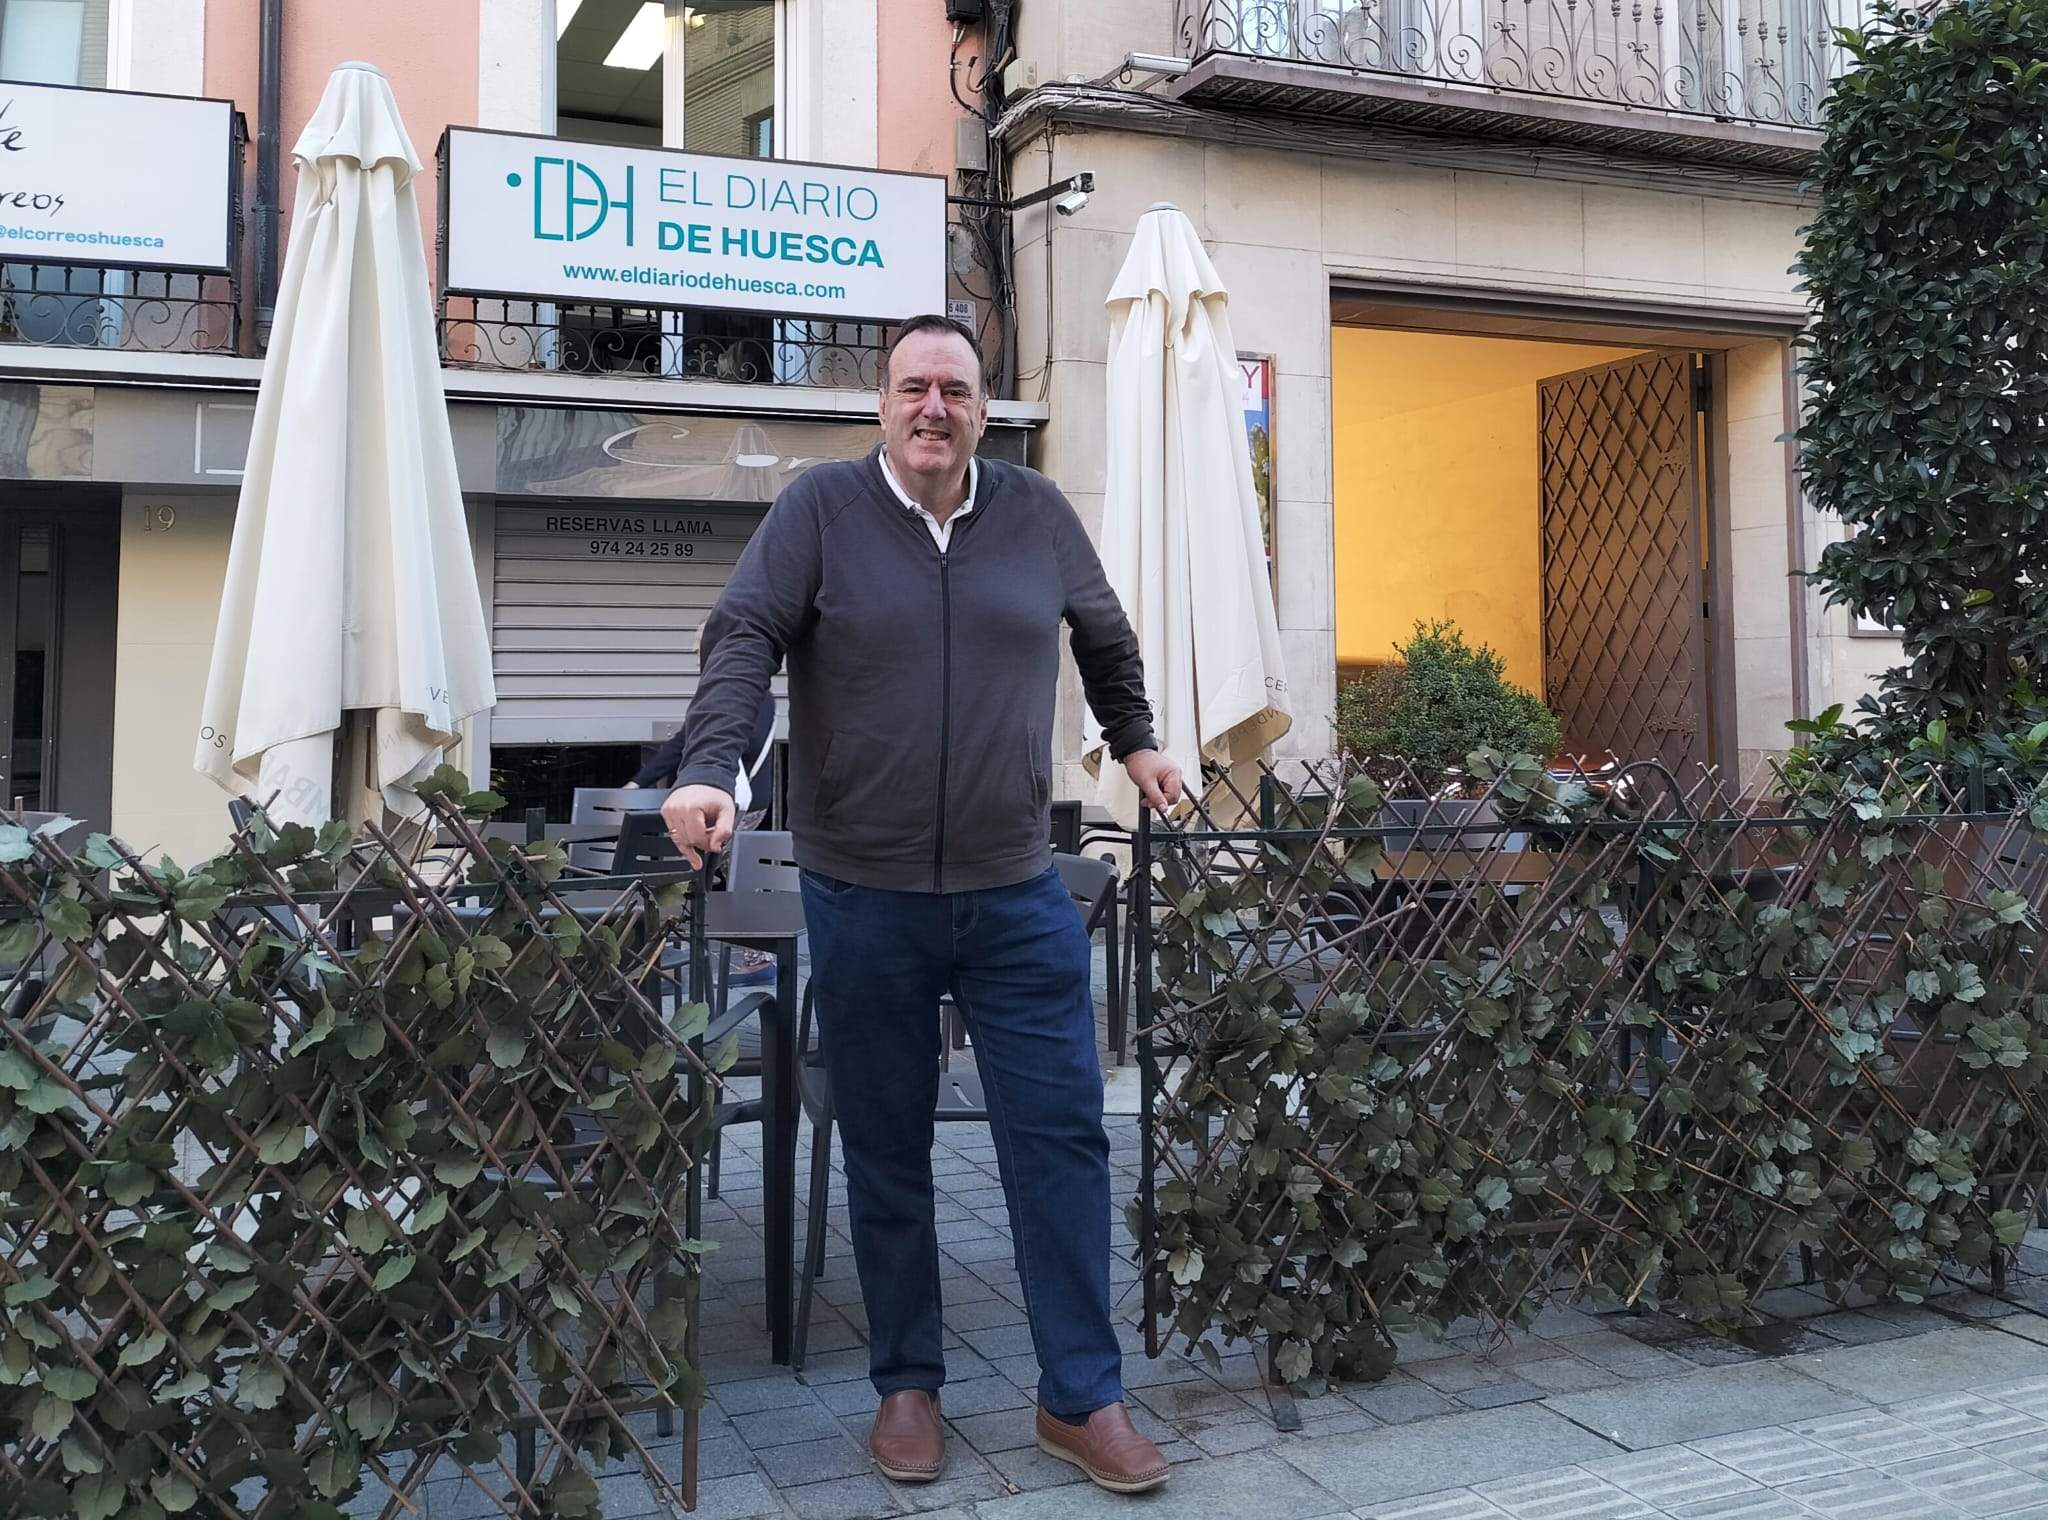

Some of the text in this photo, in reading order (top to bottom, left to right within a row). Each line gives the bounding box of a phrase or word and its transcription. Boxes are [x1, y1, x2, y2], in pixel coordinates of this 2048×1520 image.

[660, 168, 878, 221] EL DIARIO
[658, 221, 885, 268] DE HUESCA
[562, 264, 846, 299] www.eldiariodehuesca.com
[144, 504, 176, 532] 19
[546, 516, 713, 535] RESERVAS LLAMA
[590, 540, 694, 557] 974 24 25 89
